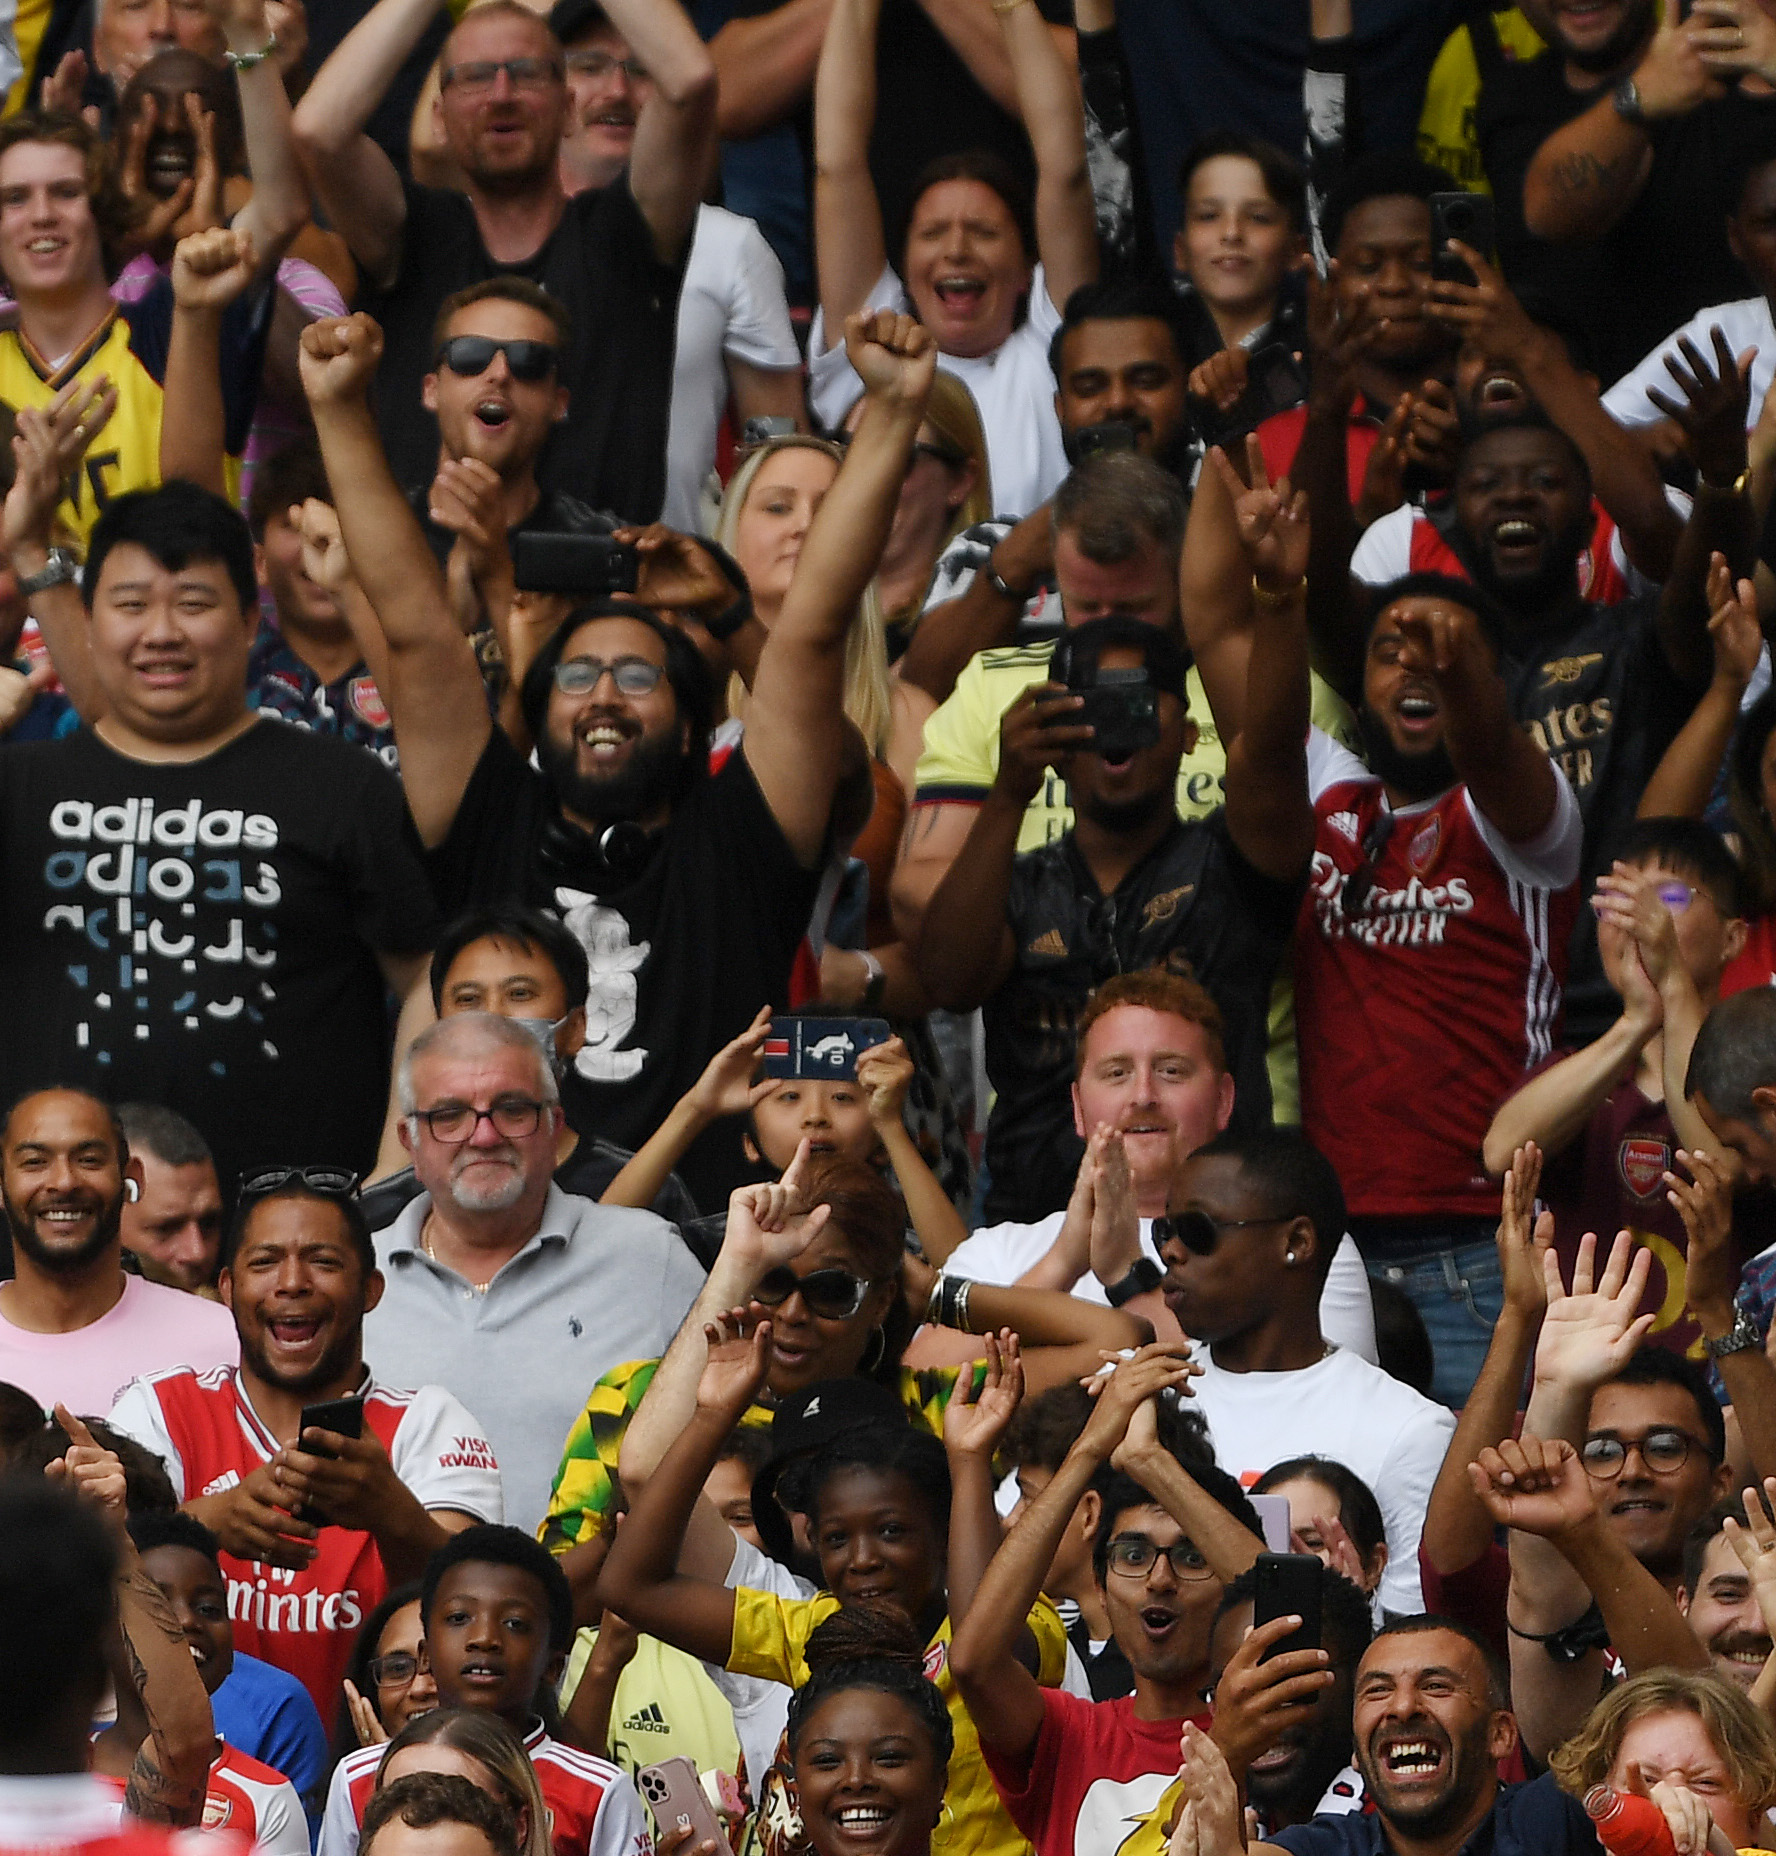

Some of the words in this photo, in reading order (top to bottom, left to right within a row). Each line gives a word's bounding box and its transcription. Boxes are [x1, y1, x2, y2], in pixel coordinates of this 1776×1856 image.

[50, 797, 279, 851] adidas
[1628, 1150, 1663, 1164] Arsenal
[623, 1717, 670, 1735] adidas
